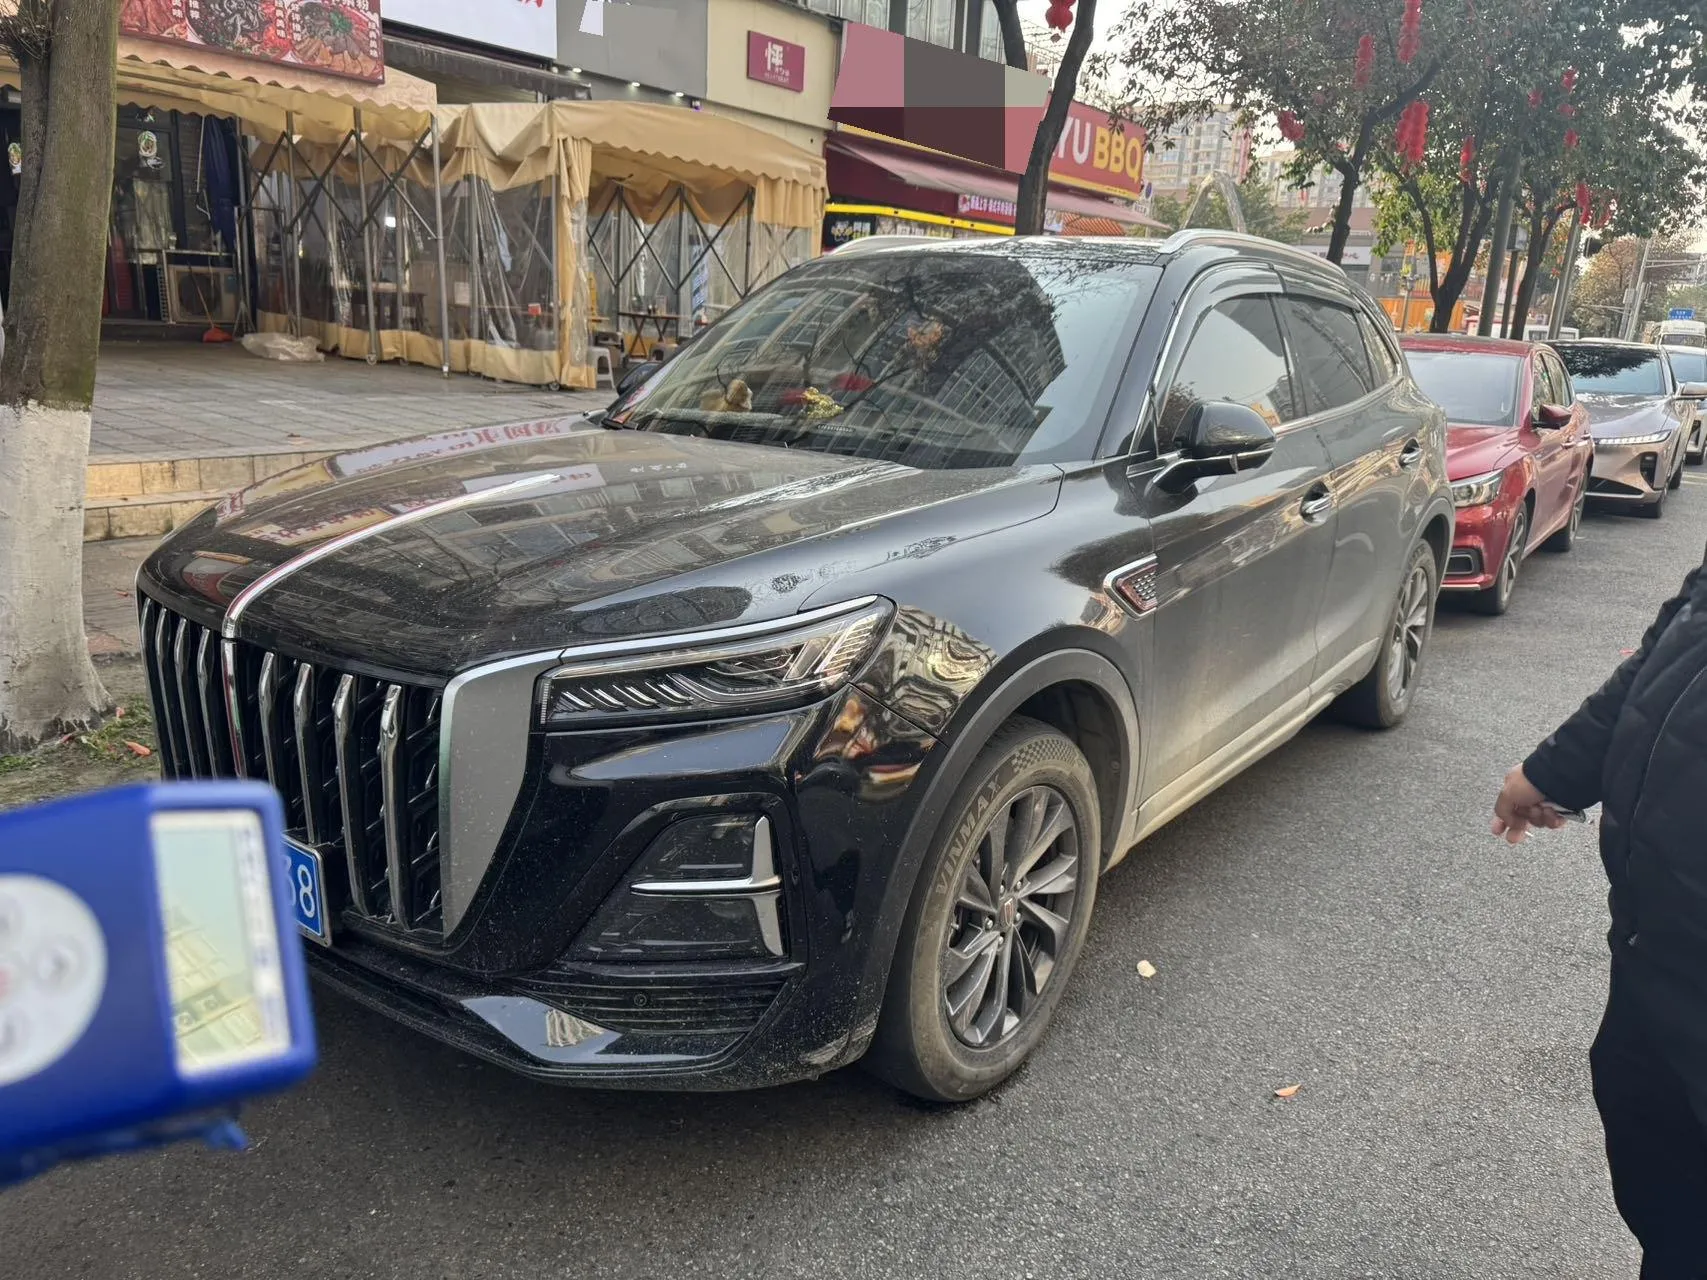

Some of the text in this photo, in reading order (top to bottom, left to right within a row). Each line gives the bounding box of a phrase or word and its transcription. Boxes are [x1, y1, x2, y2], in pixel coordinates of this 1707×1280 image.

[1052, 116, 1143, 184] YU BBQ
[935, 774, 1002, 895] VINMAX
